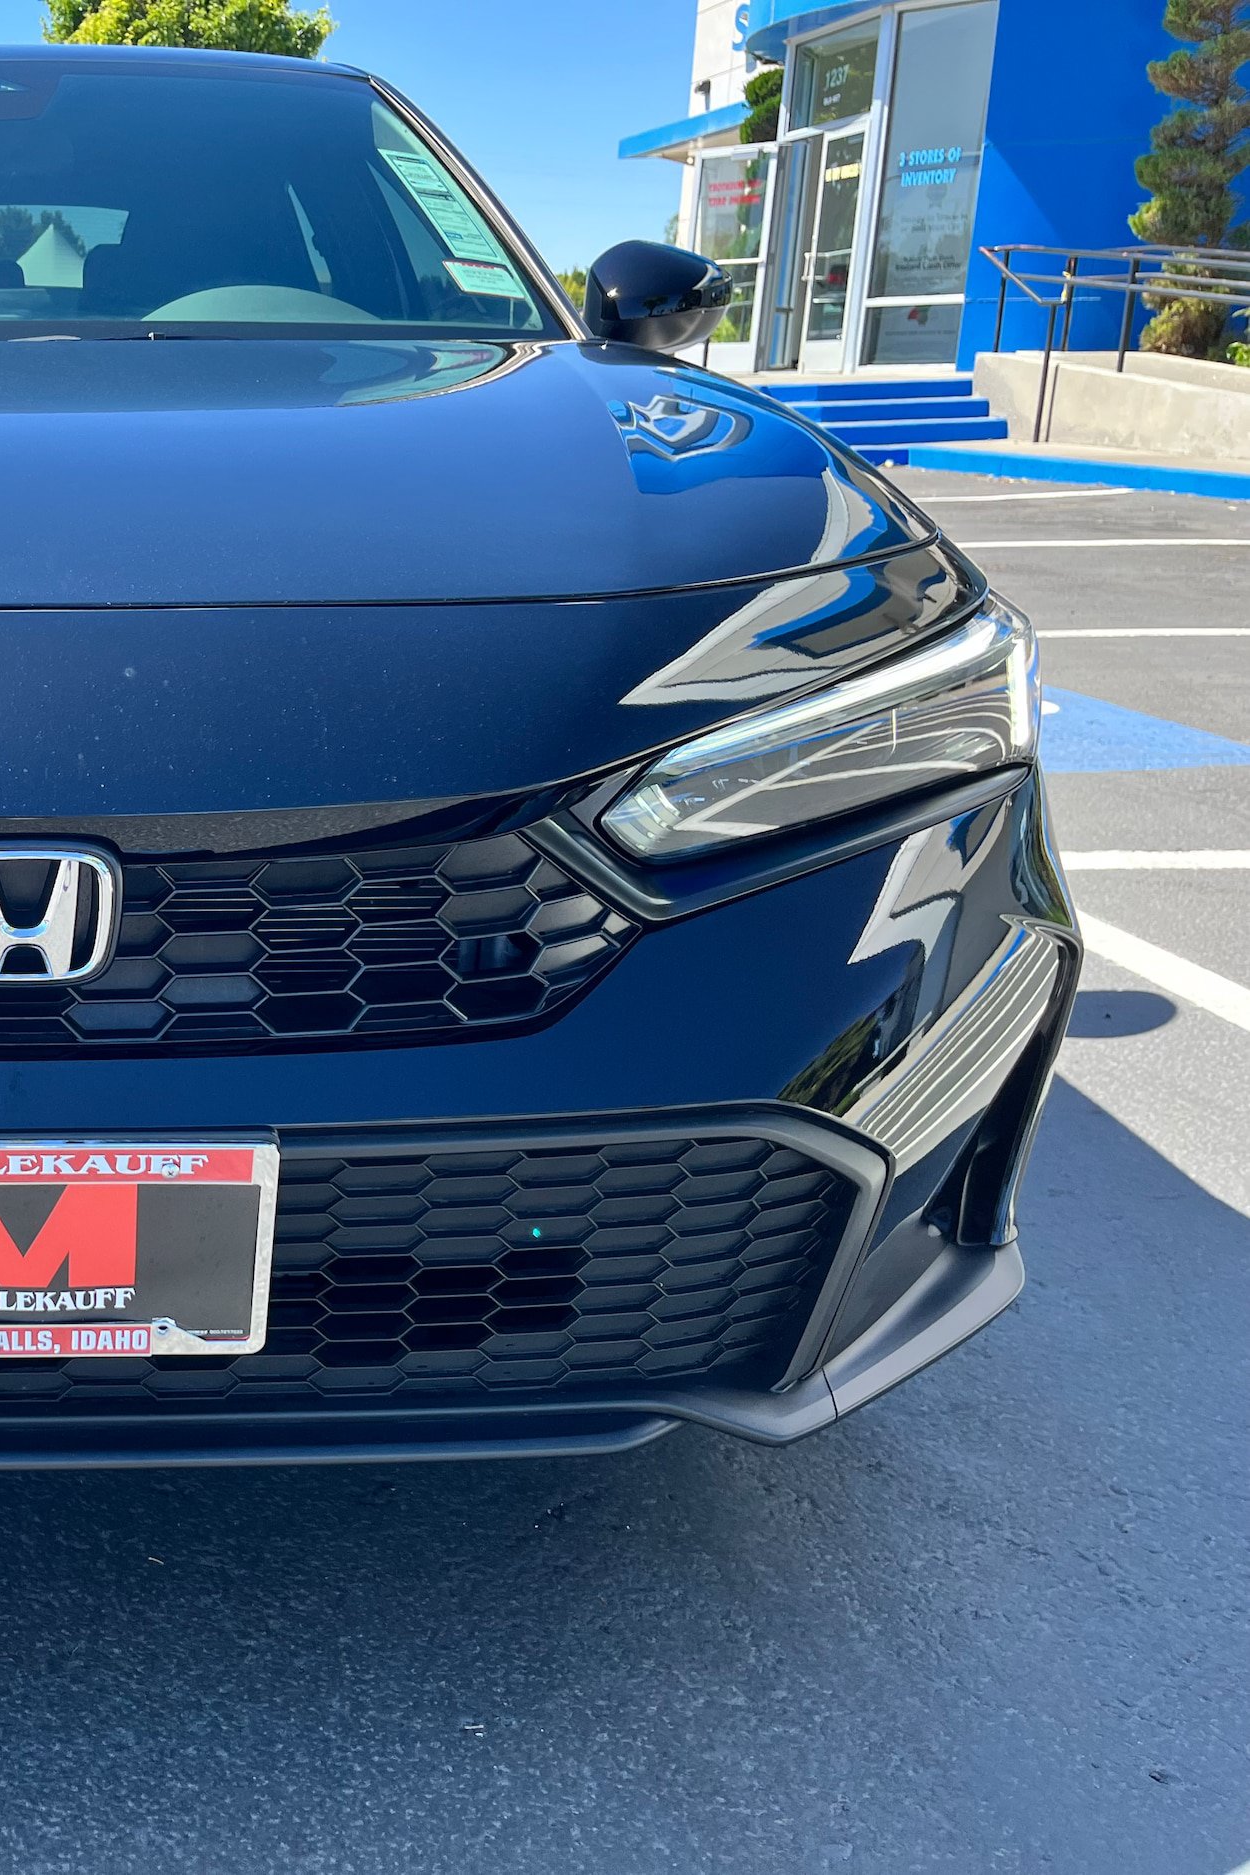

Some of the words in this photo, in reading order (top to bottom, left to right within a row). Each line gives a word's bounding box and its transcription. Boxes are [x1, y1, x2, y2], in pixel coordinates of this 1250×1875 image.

[825, 64, 850, 90] 1237
[899, 151, 906, 167] 3
[909, 148, 945, 167] STORES
[948, 147, 962, 163] OF
[901, 168, 957, 187] INVENTORY
[71, 1329, 148, 1351] IDAHO
